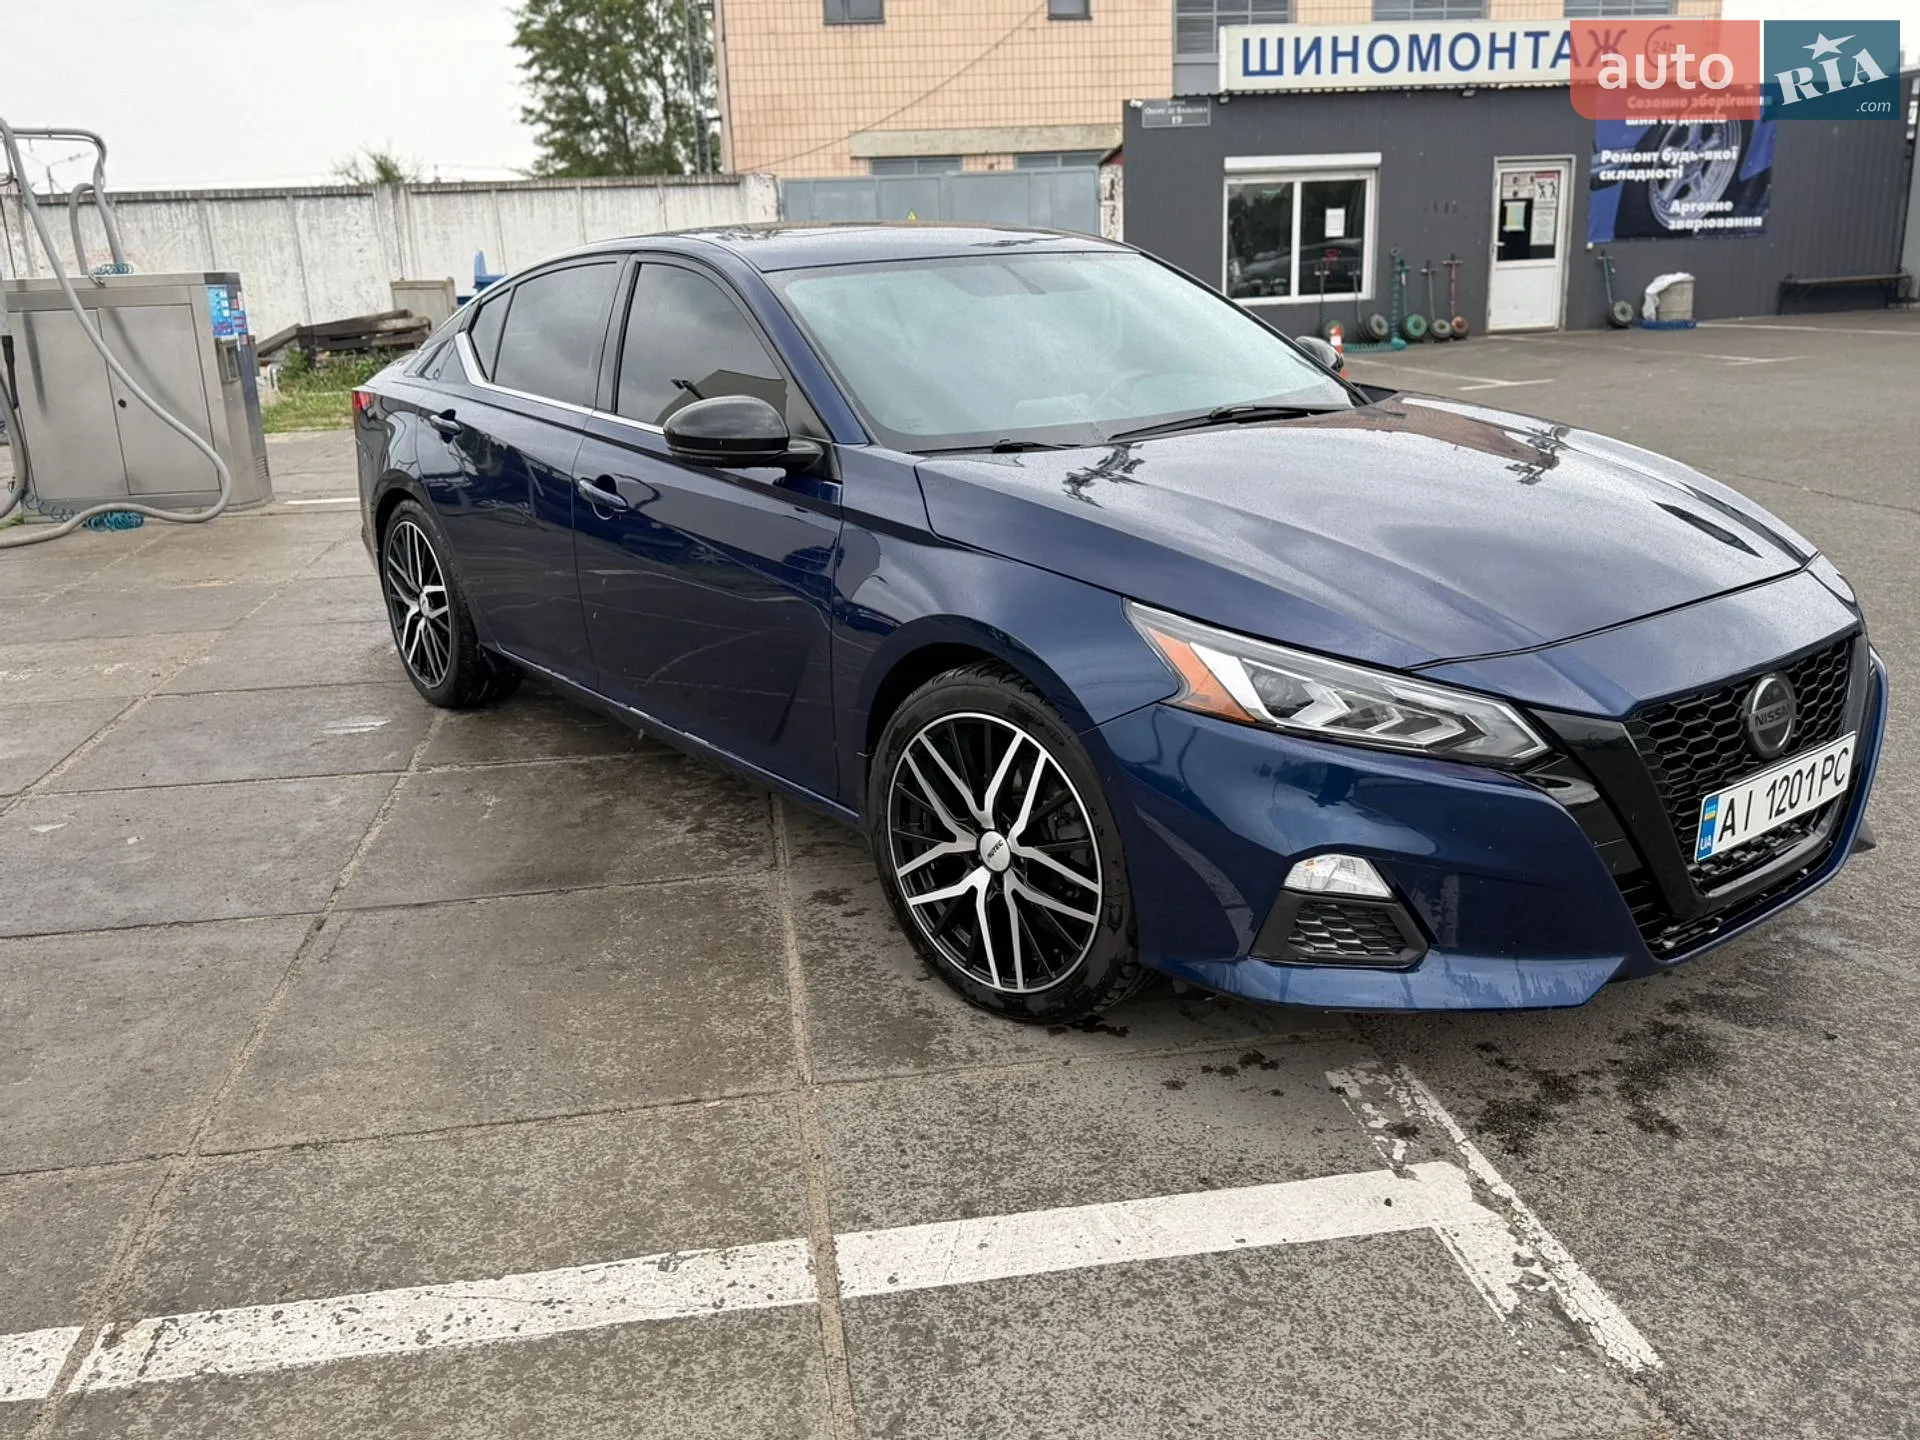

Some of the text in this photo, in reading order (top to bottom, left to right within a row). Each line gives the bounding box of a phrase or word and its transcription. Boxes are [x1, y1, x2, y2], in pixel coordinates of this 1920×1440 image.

[1241, 28, 1628, 77] ШИНОМОНТАЖ
[1601, 146, 1739, 165] Ремонт будь-якої
[1600, 165, 1684, 181] складності
[1668, 216, 1763, 232] зварювання
[1766, 762, 1818, 821] 1201
